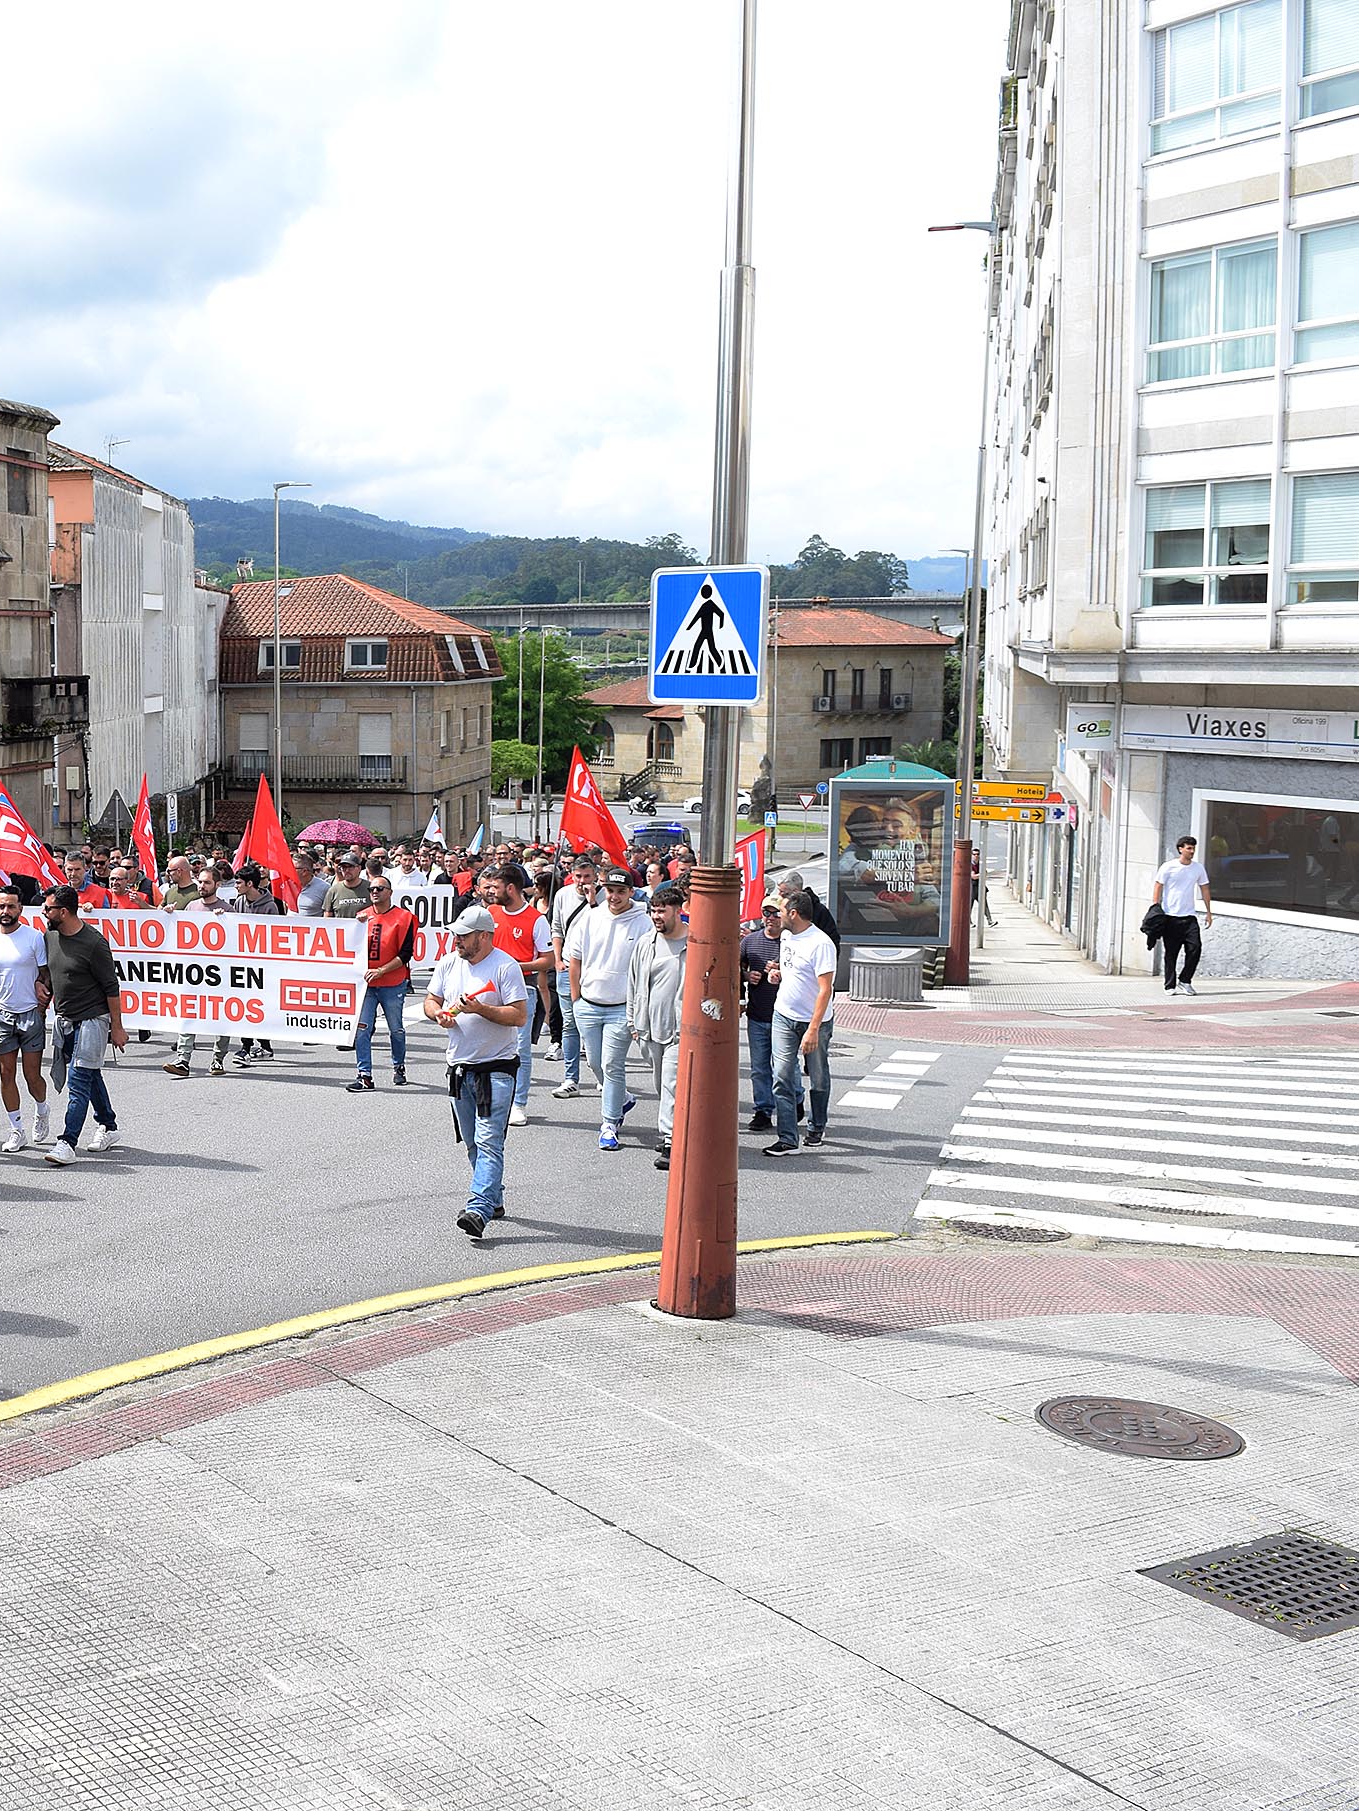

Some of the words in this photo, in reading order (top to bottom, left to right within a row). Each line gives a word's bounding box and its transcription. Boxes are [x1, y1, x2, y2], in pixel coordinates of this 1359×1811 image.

[1186, 713, 1266, 738] Viaxes
[1292, 716, 1314, 725] Oficina
[1077, 722, 1098, 733] GO
[899, 840, 915, 850] HAY
[872, 849, 915, 860] MOMENTOS
[867, 860, 883, 871] QUE
[883, 860, 905, 871] SOLO
[905, 860, 915, 871] SE
[874, 871, 904, 881] SIRVEN
[904, 871, 915, 881] EN
[886, 881, 898, 892] TU
[898, 881, 915, 892] BAR
[177, 920, 226, 951] DO
[238, 923, 355, 958] METAL
[230, 966, 264, 989] EN
[285, 985, 351, 1008] CCOO
[121, 990, 265, 1024] DEREITOS
[286, 1013, 351, 1030] industria
